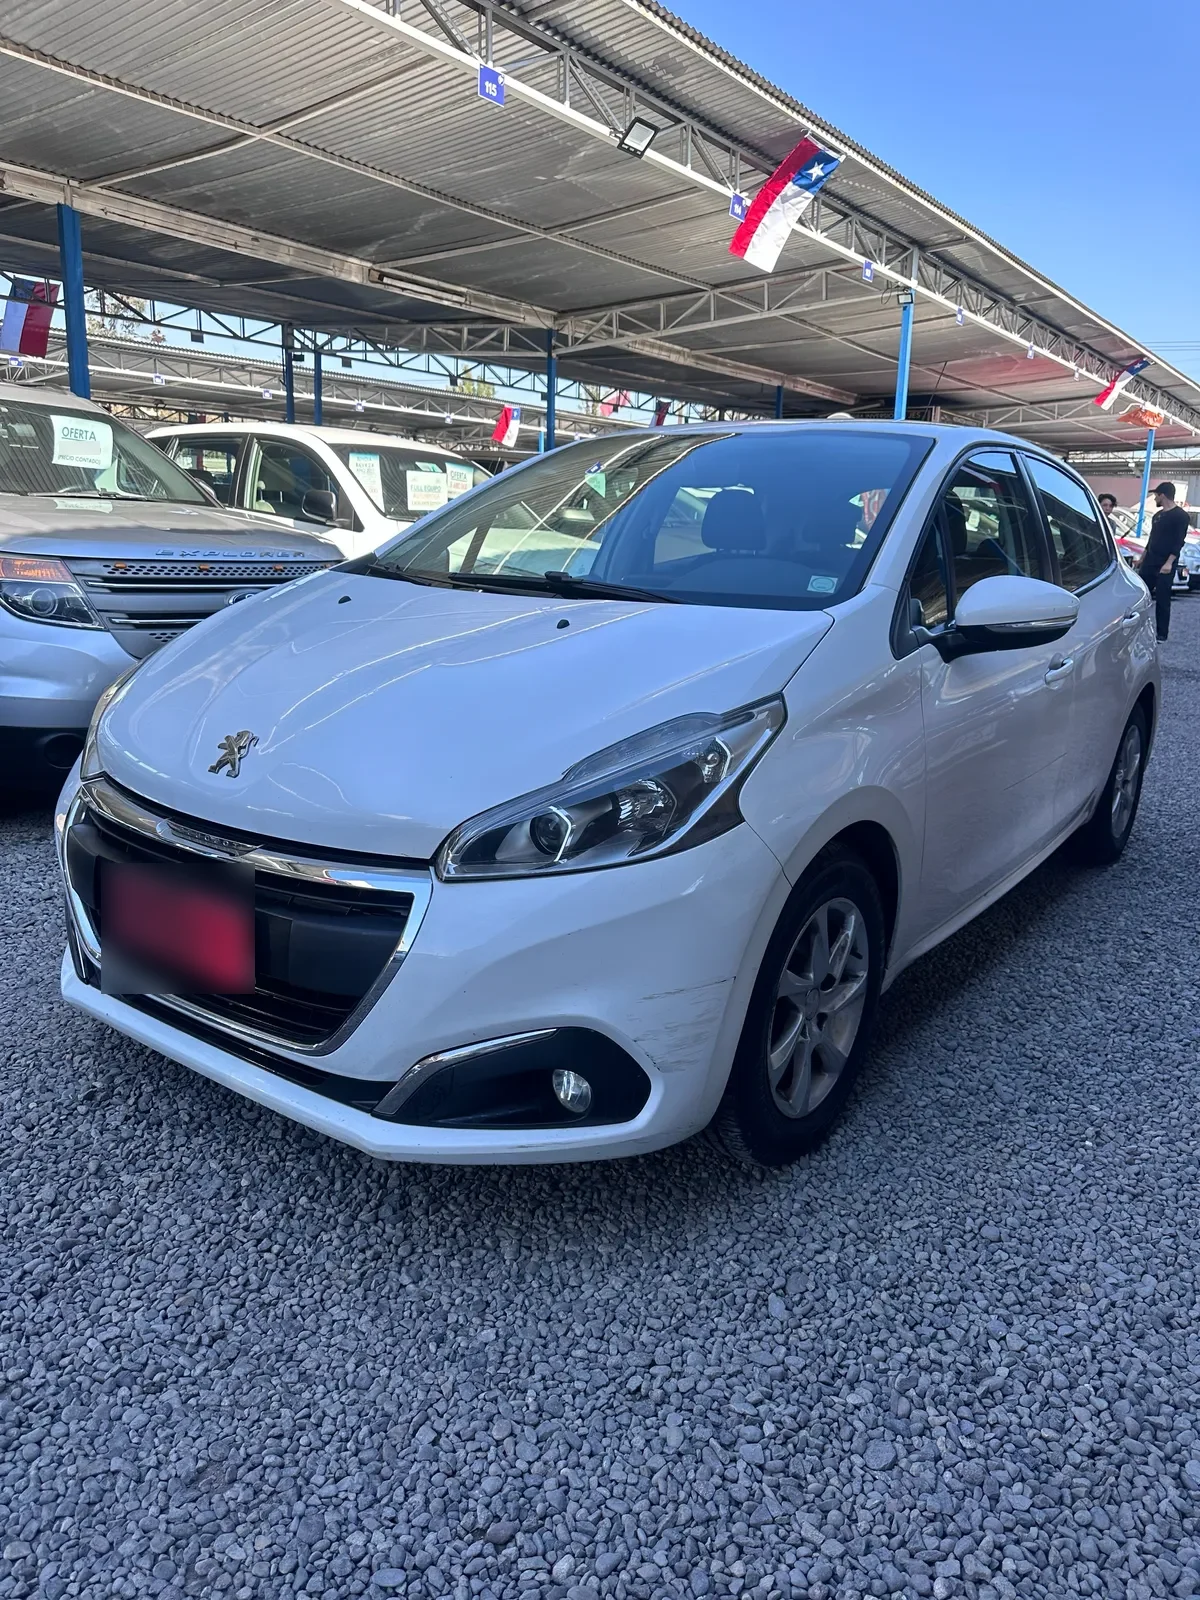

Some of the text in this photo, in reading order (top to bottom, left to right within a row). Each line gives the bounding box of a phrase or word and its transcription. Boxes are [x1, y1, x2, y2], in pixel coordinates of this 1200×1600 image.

[484, 80, 498, 97] 115
[61, 426, 97, 441] OFERTA
[155, 548, 306, 558] EXPLORER
